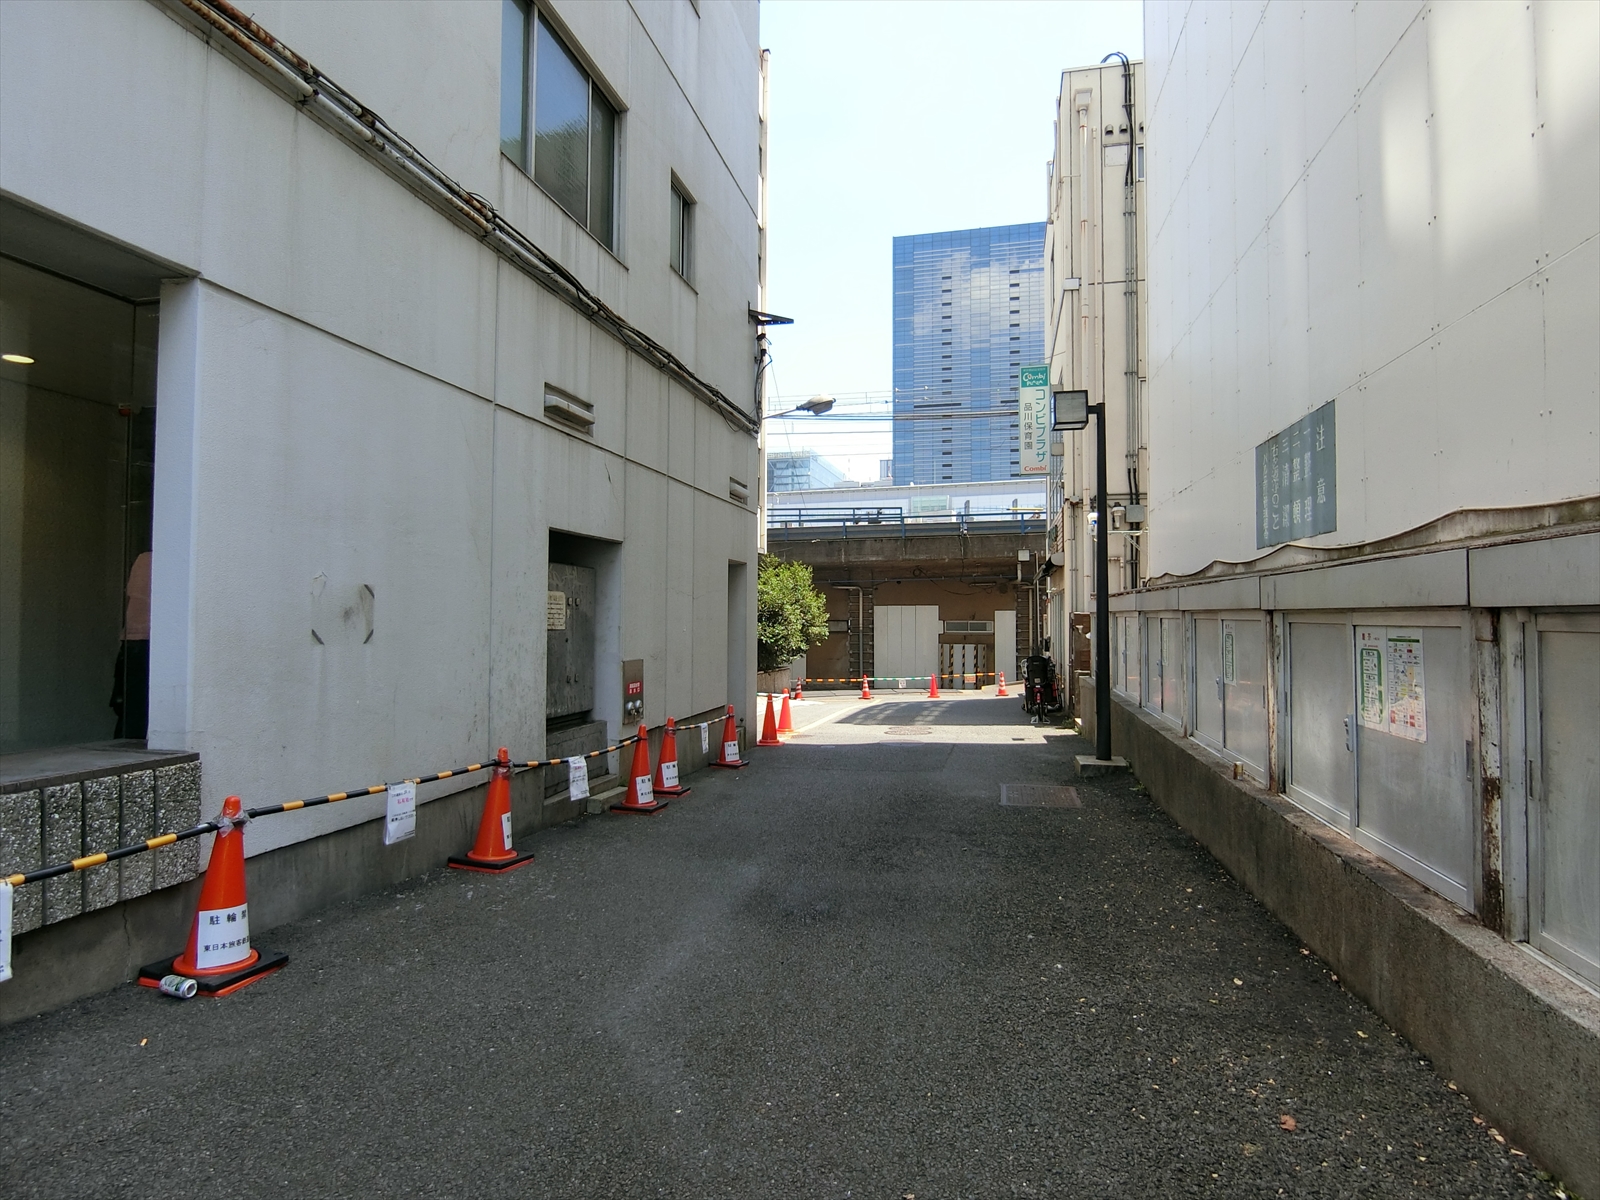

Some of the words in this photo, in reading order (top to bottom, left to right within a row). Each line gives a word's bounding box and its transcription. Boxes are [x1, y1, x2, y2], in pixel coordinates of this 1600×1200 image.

[1023, 373, 1046, 382] Combi
[1024, 403, 1033, 450] 品川保育園
[1035, 389, 1048, 463] コンビプラザ
